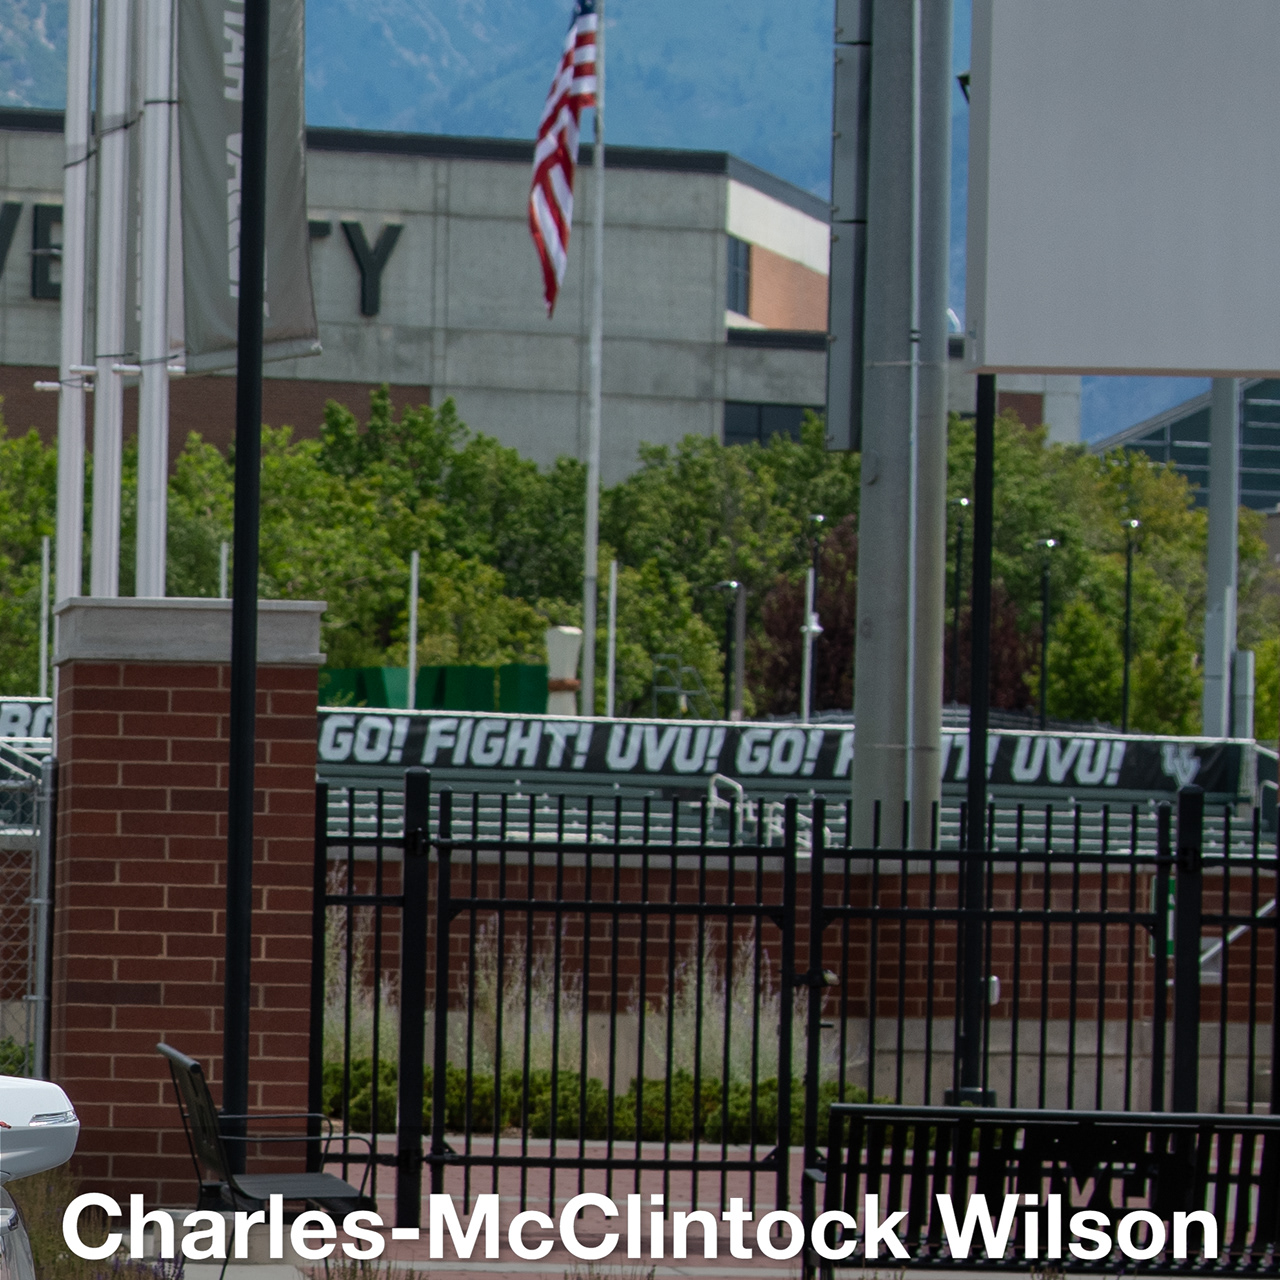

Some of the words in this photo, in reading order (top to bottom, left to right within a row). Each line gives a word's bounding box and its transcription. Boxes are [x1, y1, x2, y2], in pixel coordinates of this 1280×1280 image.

[319, 714, 409, 763] GO!
[421, 717, 594, 770] FIGHT!
[605, 723, 727, 774] UVU!
[736, 728, 826, 777] GO!
[1011, 736, 1127, 787] UVU!
